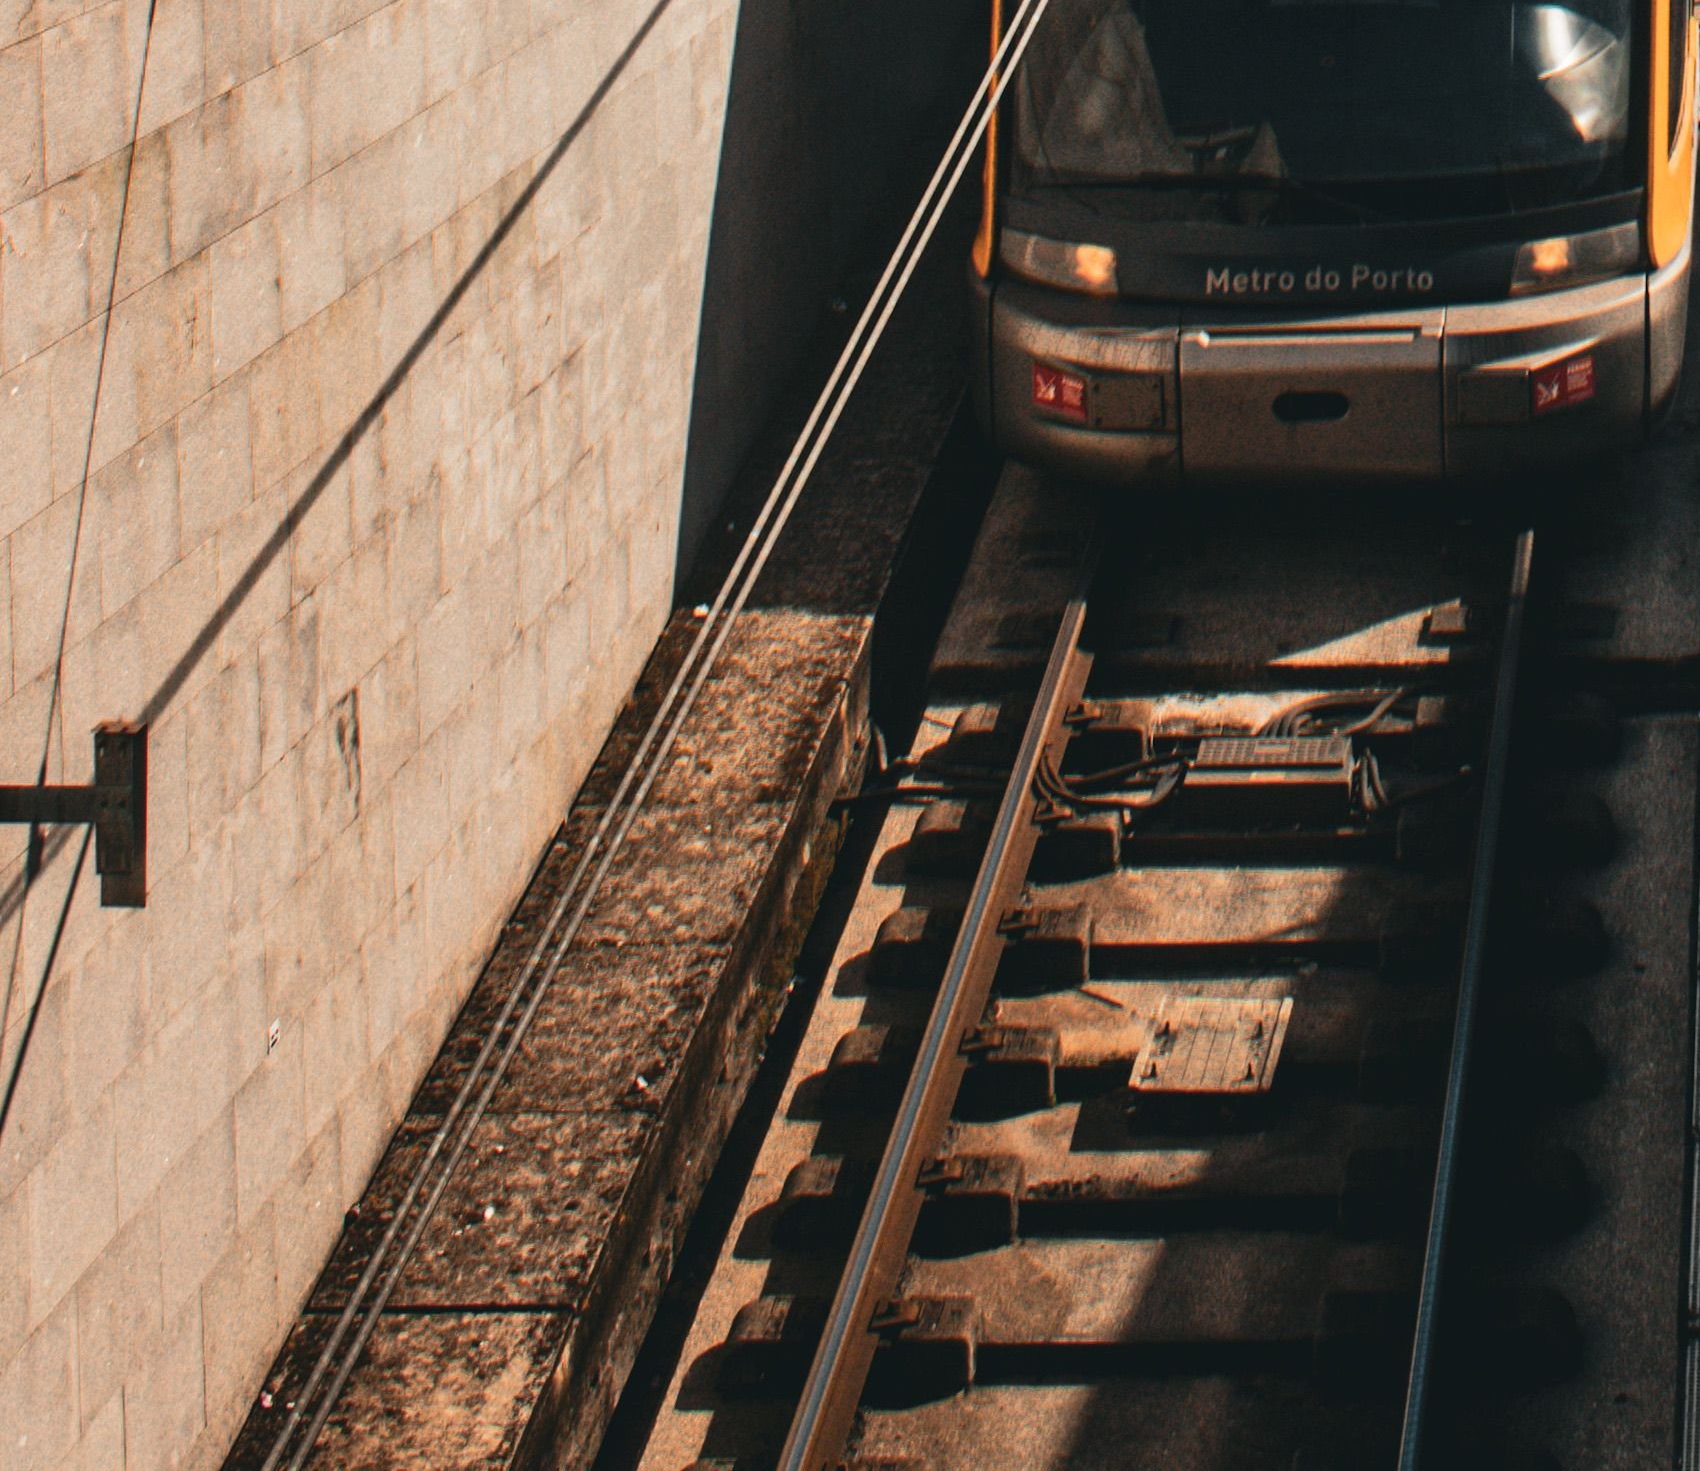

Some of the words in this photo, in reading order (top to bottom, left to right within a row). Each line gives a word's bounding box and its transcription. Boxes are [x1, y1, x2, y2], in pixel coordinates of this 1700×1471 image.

[1205, 266, 1295, 296] Metro
[1304, 263, 1341, 292] do
[1351, 263, 1435, 292] Porto
